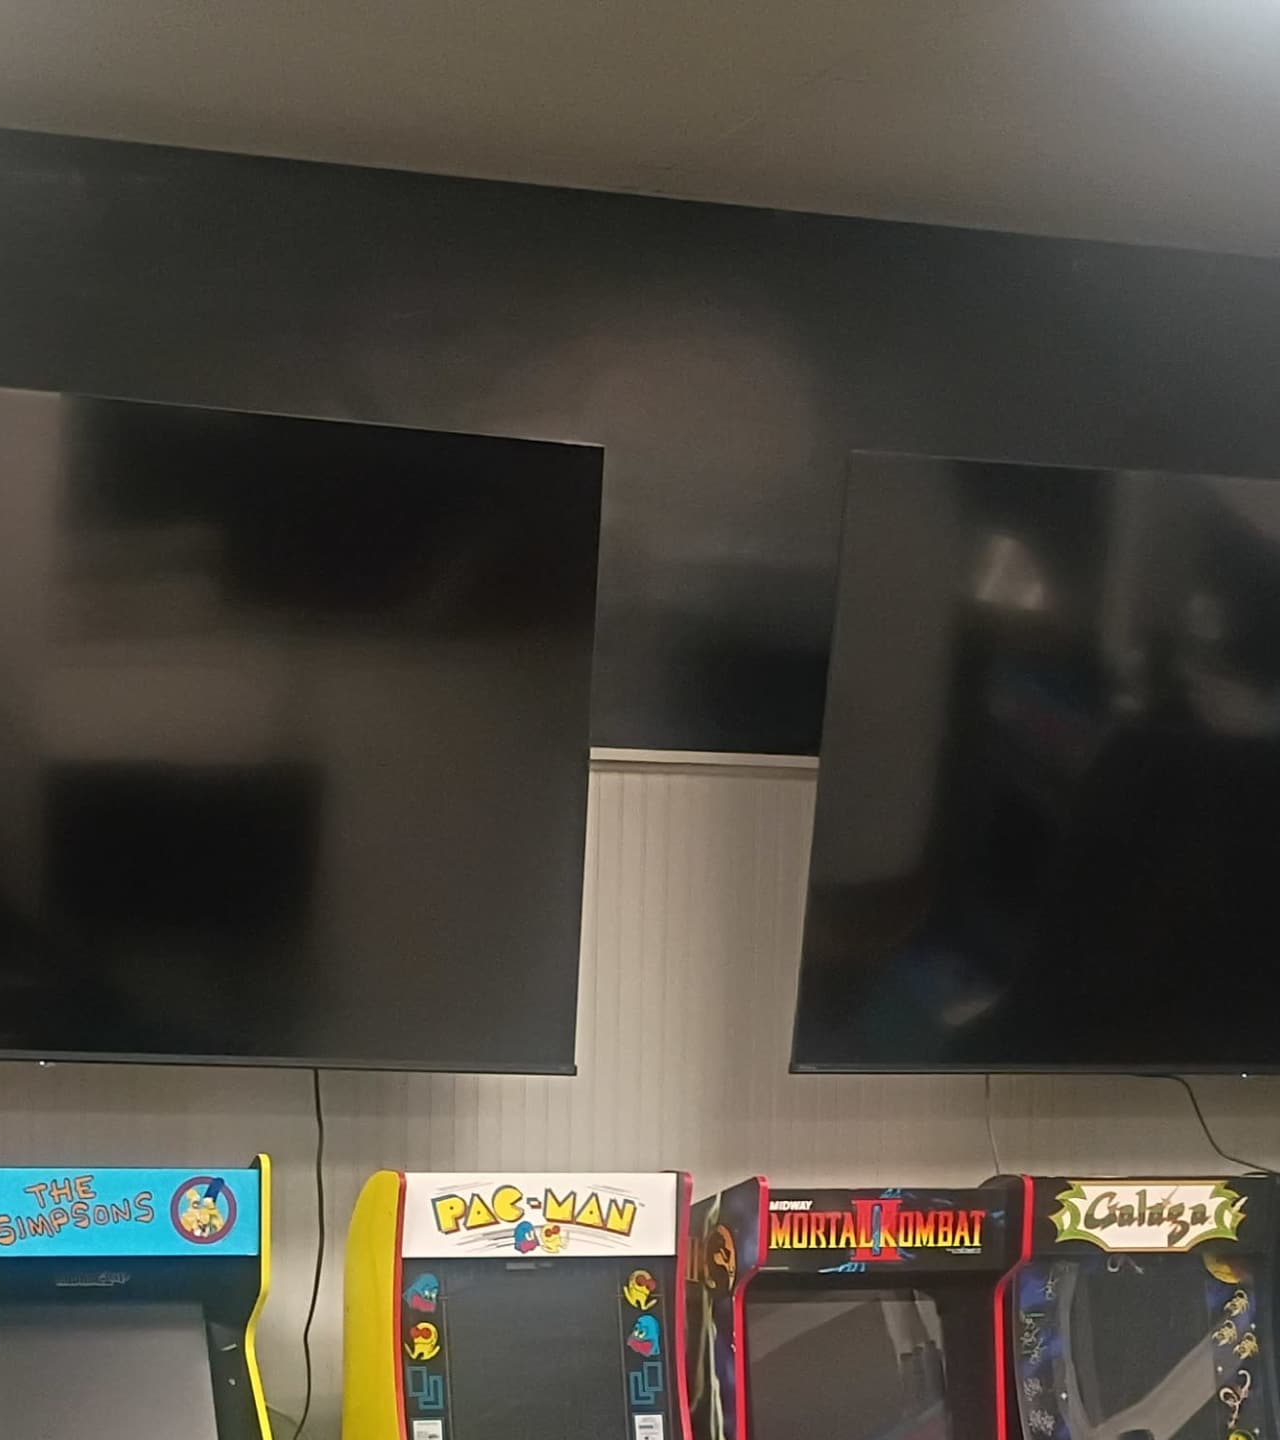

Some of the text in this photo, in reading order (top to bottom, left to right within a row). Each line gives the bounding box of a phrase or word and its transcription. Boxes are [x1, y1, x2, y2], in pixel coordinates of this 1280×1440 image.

[24, 1174, 97, 1209] THE
[431, 1184, 638, 1236] PAC-MAN
[769, 1200, 813, 1211] MIDWAY
[769, 1211, 874, 1249] MORTAL
[879, 1210, 987, 1248] KOMBAT
[1084, 1188, 1212, 1248] Galaga
